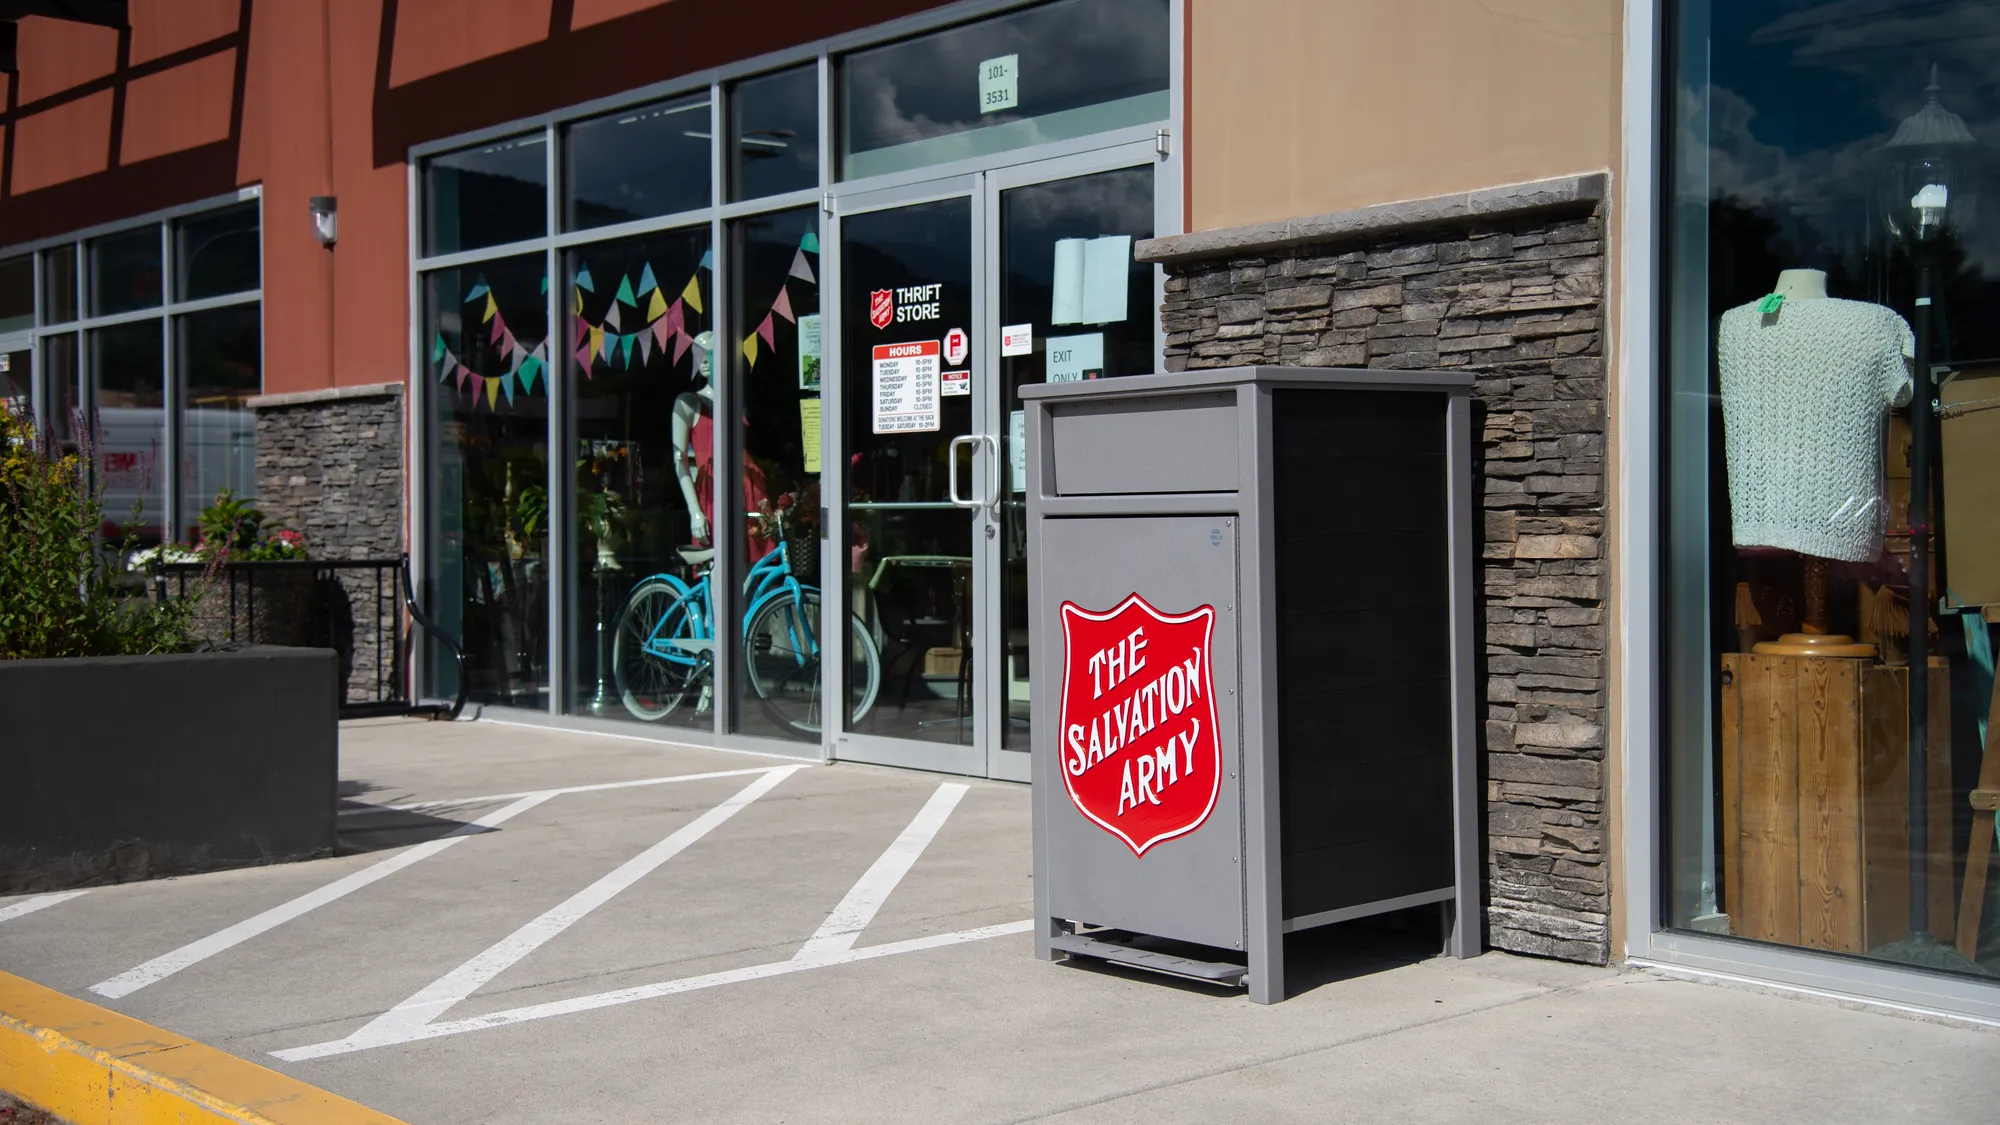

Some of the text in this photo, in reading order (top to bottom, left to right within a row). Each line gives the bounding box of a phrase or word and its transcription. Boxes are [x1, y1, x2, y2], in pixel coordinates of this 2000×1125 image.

[988, 65, 1008, 80] 101-
[986, 89, 1009, 105] 3531
[897, 284, 942, 304] THRIFT
[897, 303, 940, 322] STORE
[889, 345, 922, 357] HOURS
[1053, 350, 1072, 363] EXIT
[1089, 626, 1149, 700] THE
[1068, 646, 1201, 777] SALVATION
[1117, 717, 1200, 816] ARMY
